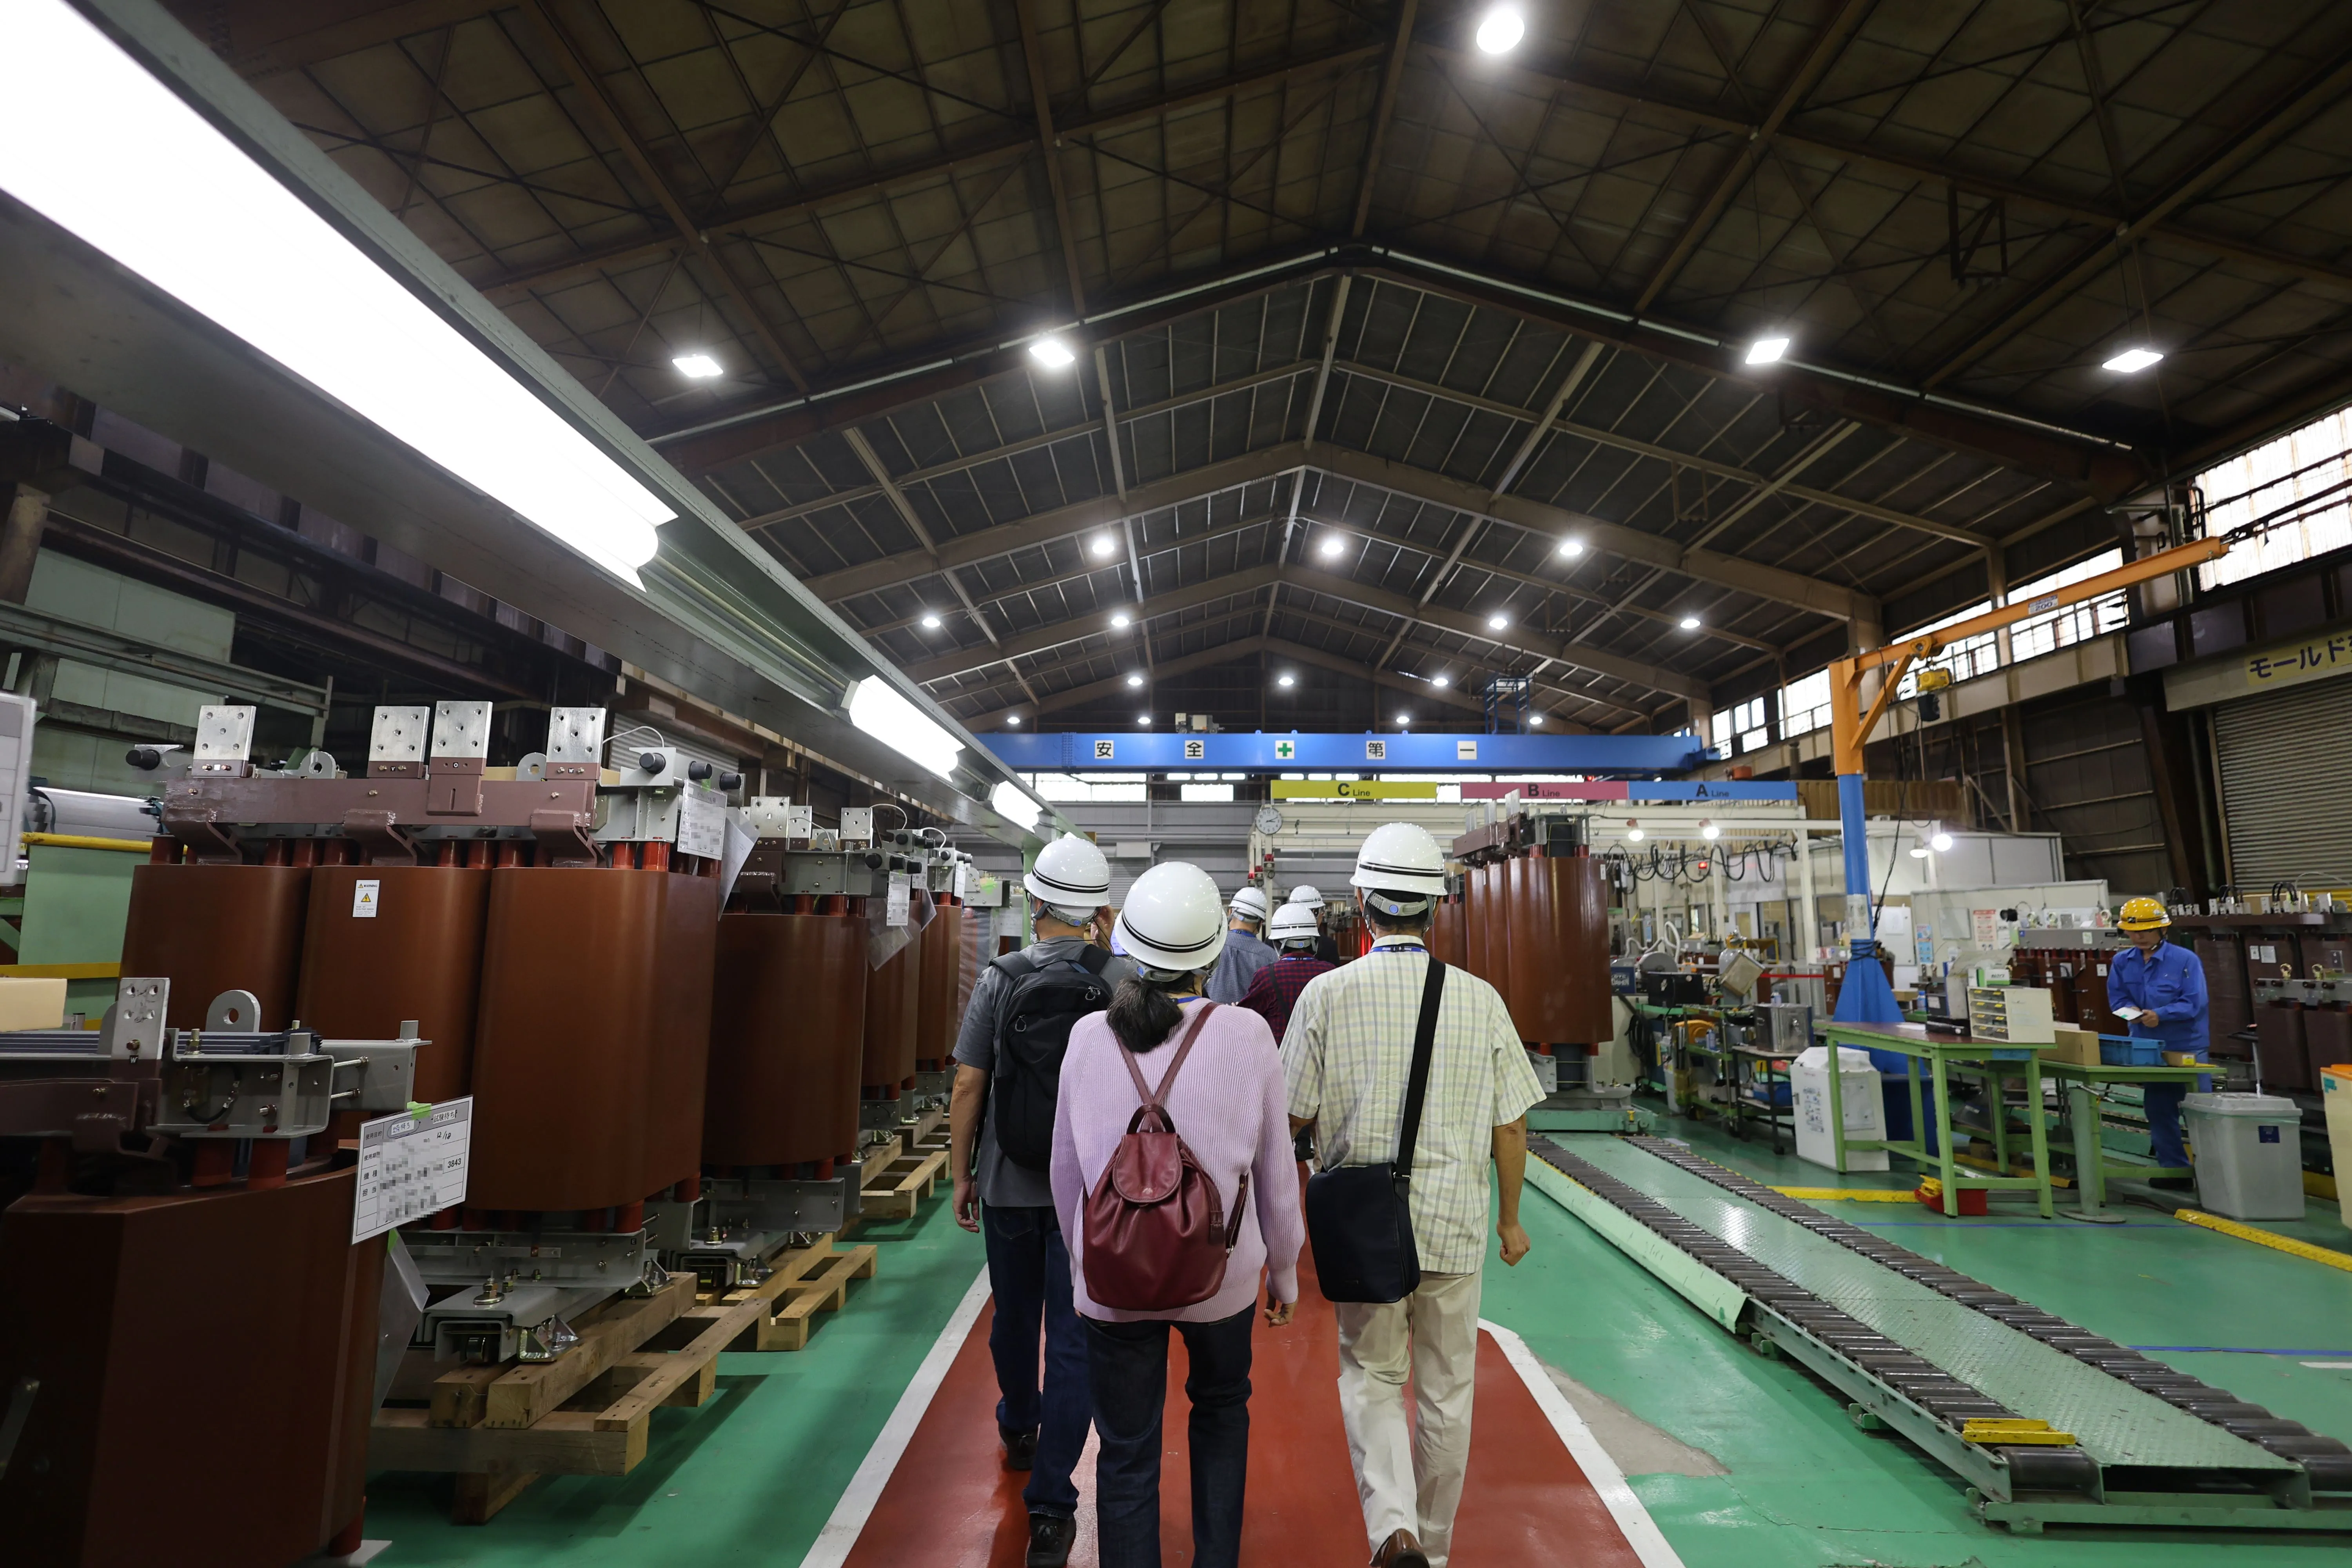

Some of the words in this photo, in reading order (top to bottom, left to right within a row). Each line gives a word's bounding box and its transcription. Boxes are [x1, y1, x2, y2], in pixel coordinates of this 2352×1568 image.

[2035, 602, 2053, 611] 200
[2249, 635, 2352, 678] モールド
[1338, 782, 1350, 796] C
[1528, 784, 1539, 797] B
[1696, 784, 1708, 797] A
[365, 1131, 382, 1140] 使用目的
[433, 1111, 455, 1123] 試験待ち
[437, 1131, 451, 1140] 12/18
[448, 1158, 461, 1168] 3843
